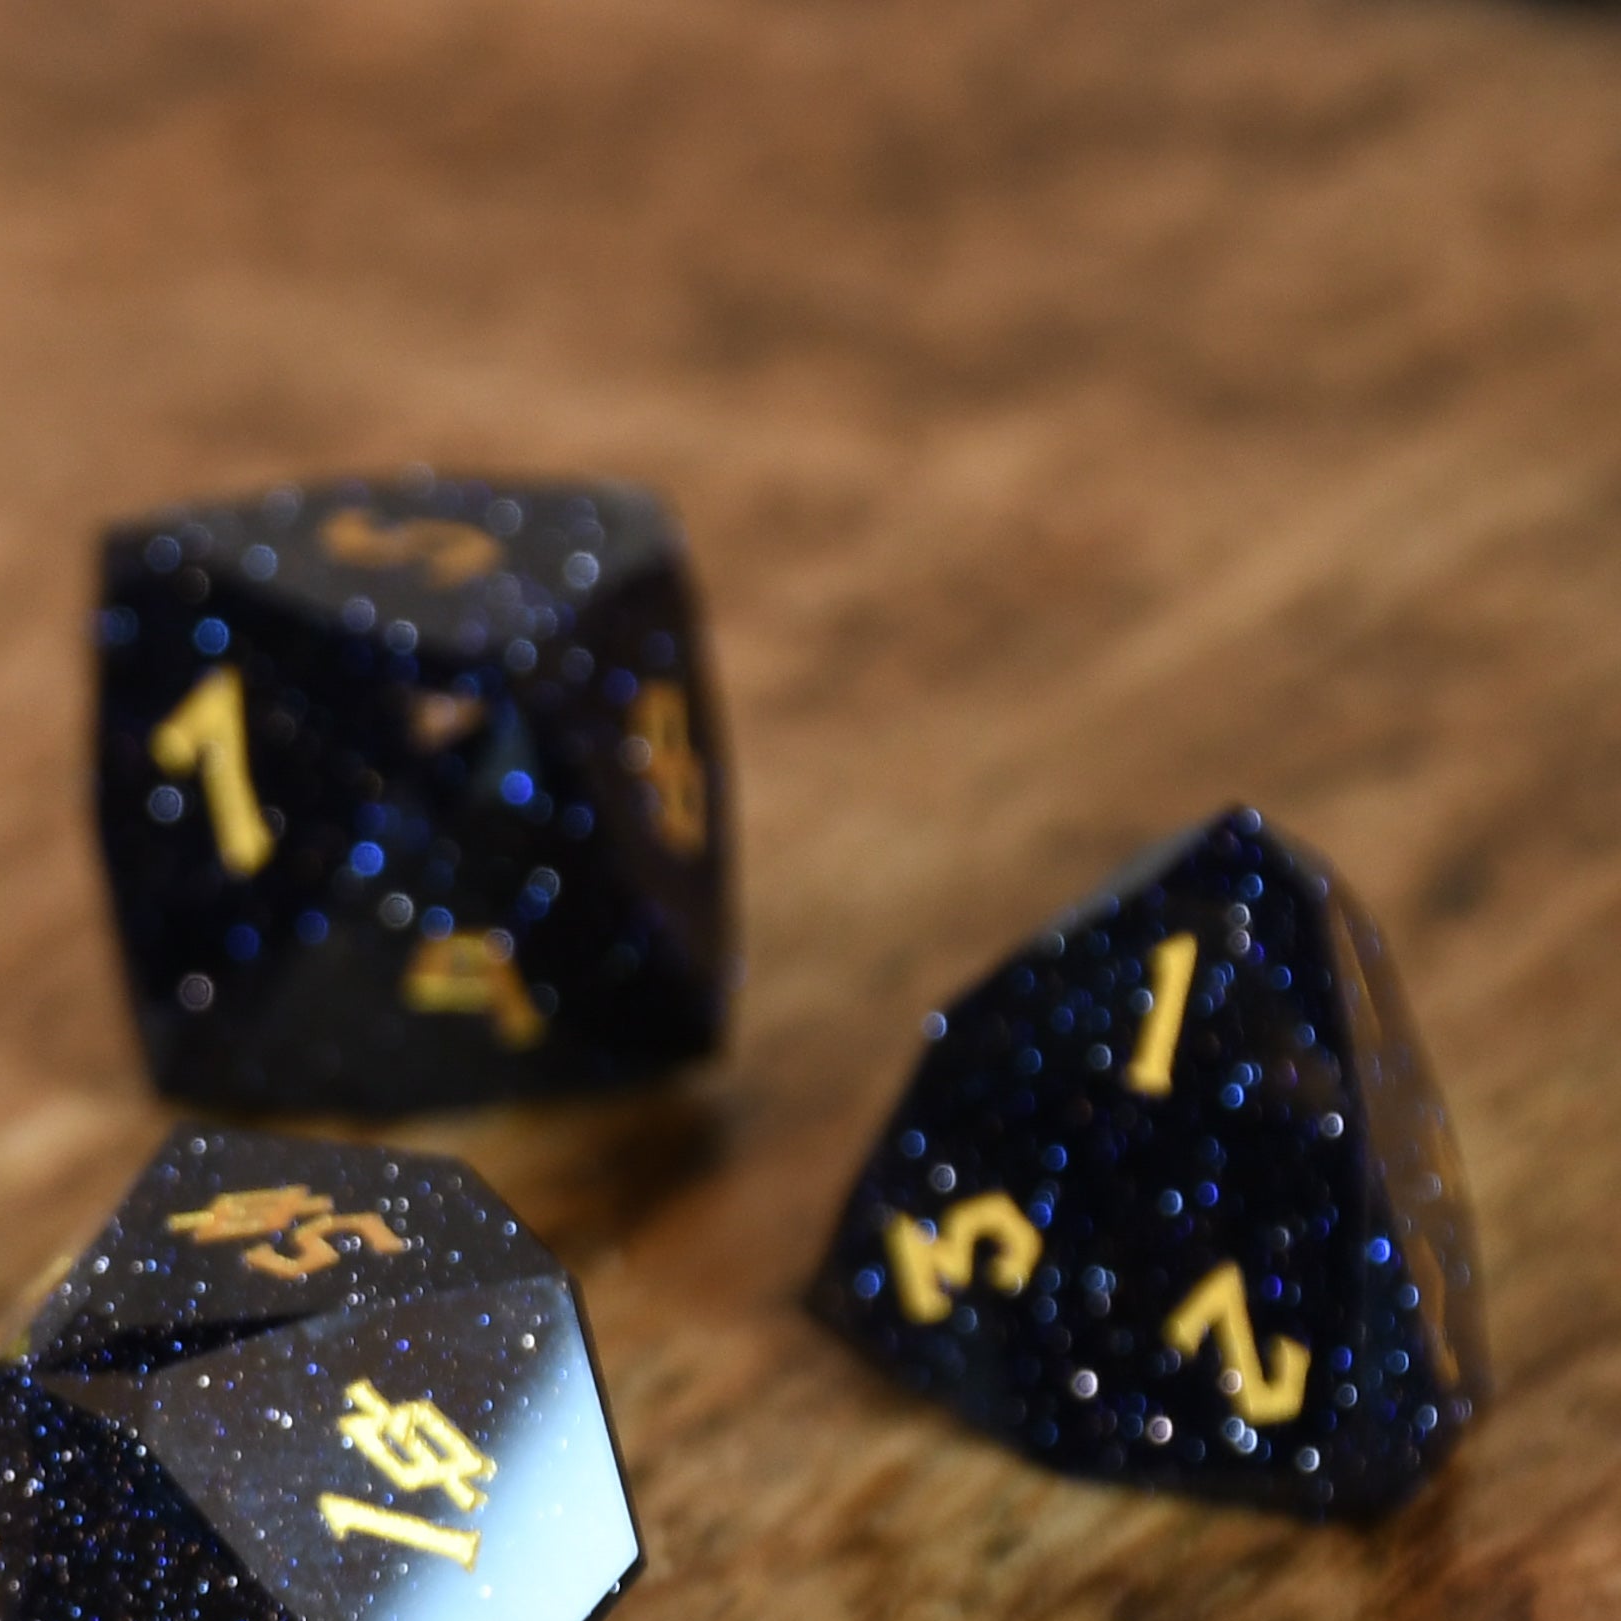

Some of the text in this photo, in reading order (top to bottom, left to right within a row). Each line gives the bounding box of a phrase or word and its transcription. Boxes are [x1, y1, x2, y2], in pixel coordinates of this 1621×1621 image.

[1130, 935, 1197, 1093] 1
[889, 1194, 1042, 1321] 3
[1169, 1265, 1310, 1423] 2
